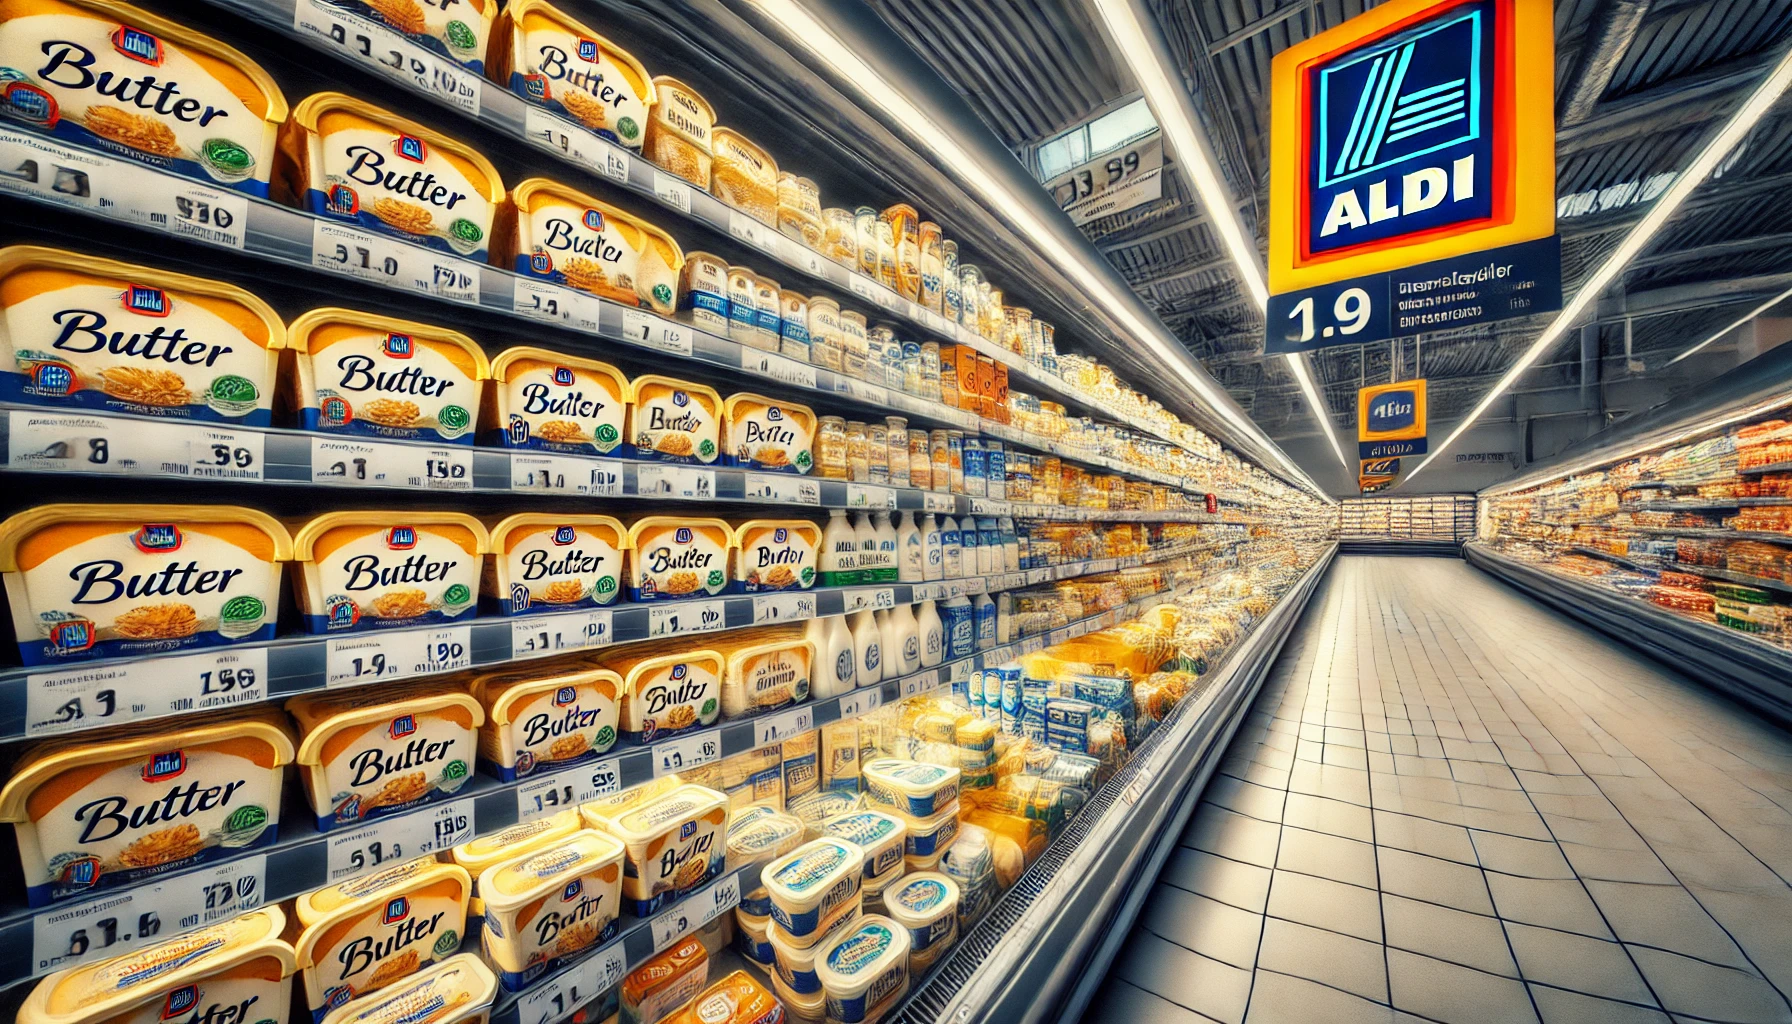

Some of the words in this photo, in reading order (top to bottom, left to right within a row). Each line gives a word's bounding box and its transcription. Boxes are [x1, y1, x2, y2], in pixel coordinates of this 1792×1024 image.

[38, 40, 229, 128] Butter
[346, 145, 467, 210] Butter
[1320, 154, 1475, 237] ALDI
[52, 309, 234, 368] Butter
[1288, 287, 1372, 343] 1.9
[69, 559, 243, 606] Butter
[343, 553, 457, 592] Butter
[350, 736, 456, 788] Butter
[74, 779, 246, 845] Butter
